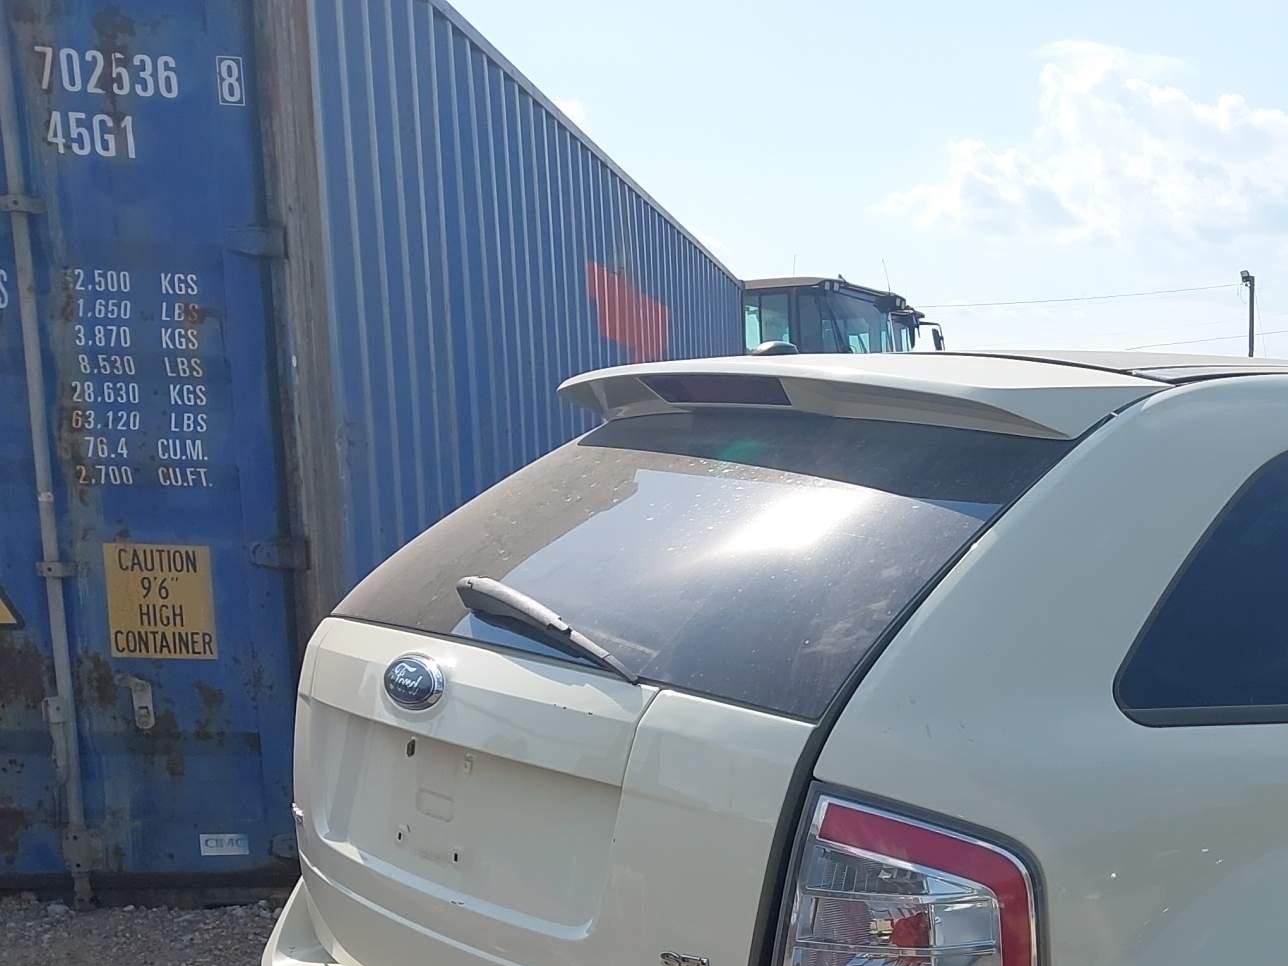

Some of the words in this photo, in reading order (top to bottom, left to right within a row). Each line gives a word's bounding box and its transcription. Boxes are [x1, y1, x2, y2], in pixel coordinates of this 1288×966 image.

[33, 45, 179, 98] 702536
[219, 59, 241, 102] 8
[47, 110, 136, 159] 45G1
[160, 272, 199, 295] KGS
[161, 302, 200, 321] LBS
[161, 327, 199, 350] KGS
[164, 357, 203, 377] LBS
[169, 384, 207, 406] KGS
[170, 413, 208, 432] LBS
[83, 437, 129, 459] 76.4
[157, 438, 209, 461] CU.M.
[117, 548, 198, 574] CAUTION
[138, 603, 185, 628] HIGH
[114, 630, 214, 656] CONTAINER
